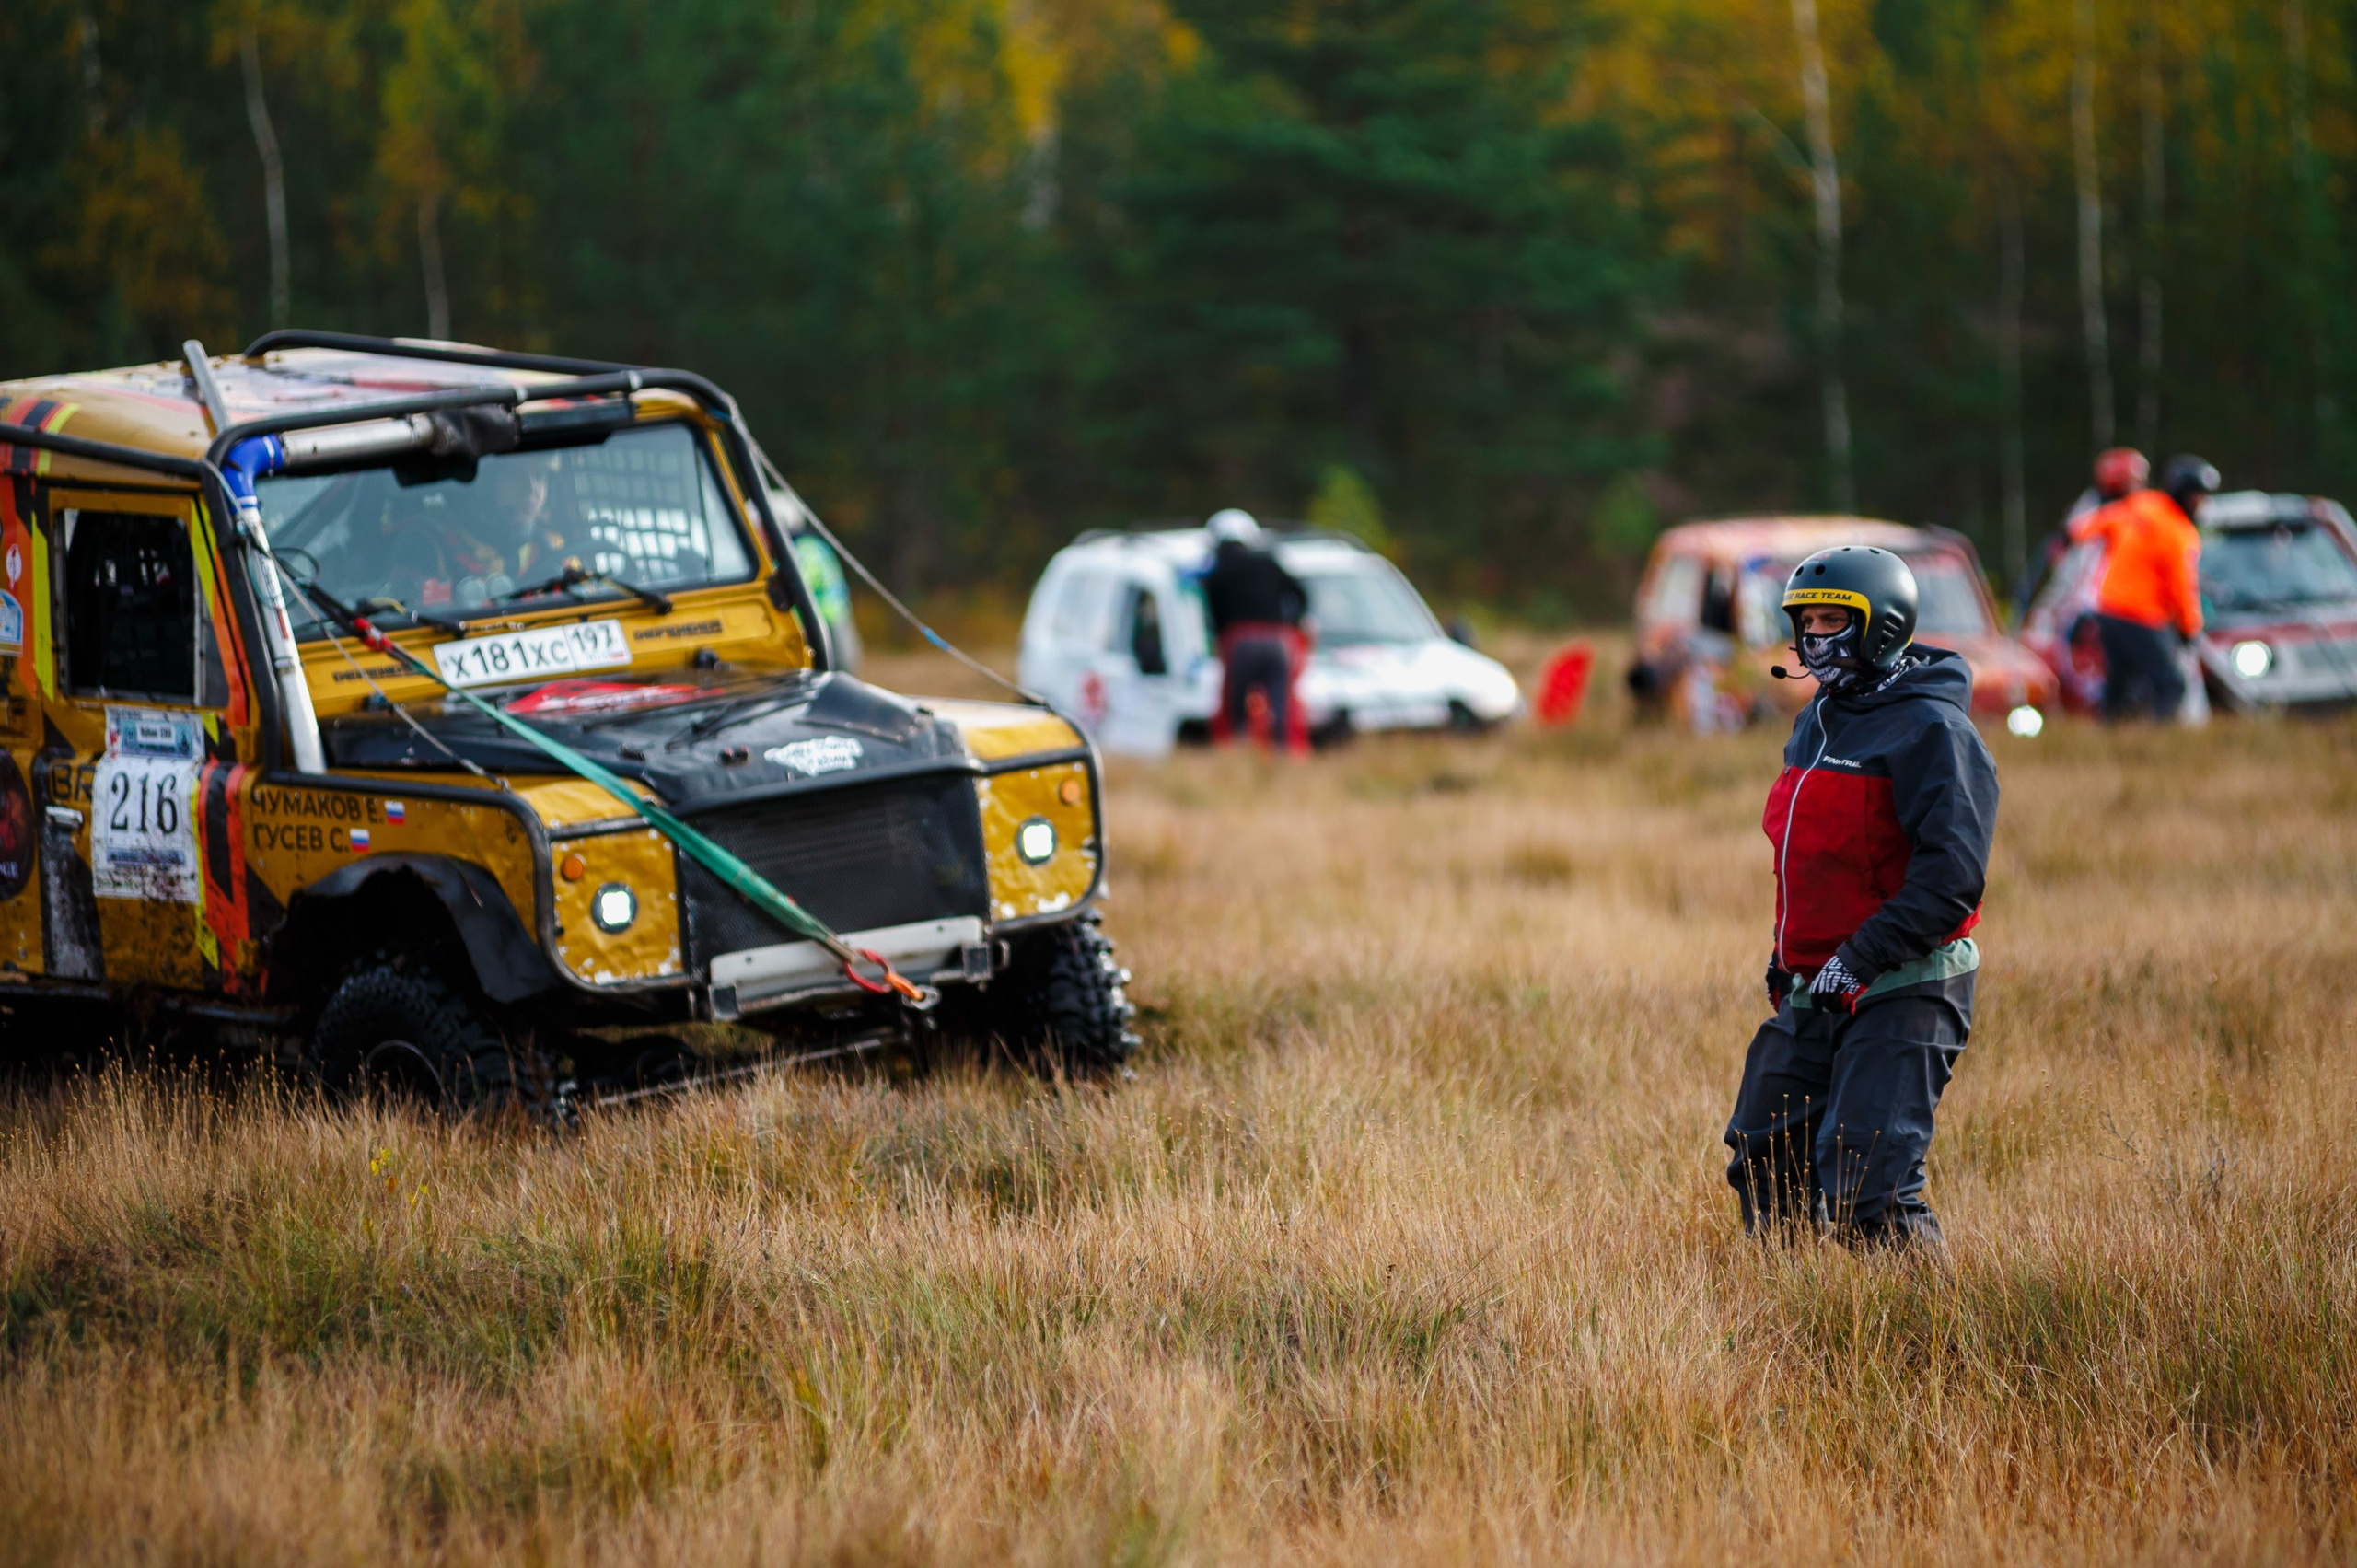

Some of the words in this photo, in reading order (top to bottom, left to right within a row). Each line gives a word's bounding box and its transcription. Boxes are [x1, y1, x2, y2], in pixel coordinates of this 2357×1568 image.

[1794, 591, 1818, 599] RACE
[1820, 591, 1852, 601] TEAM
[110, 772, 178, 834] 216
[250, 784, 362, 821] ЧУМАКОВ
[252, 822, 324, 852] ГУСЕВ
